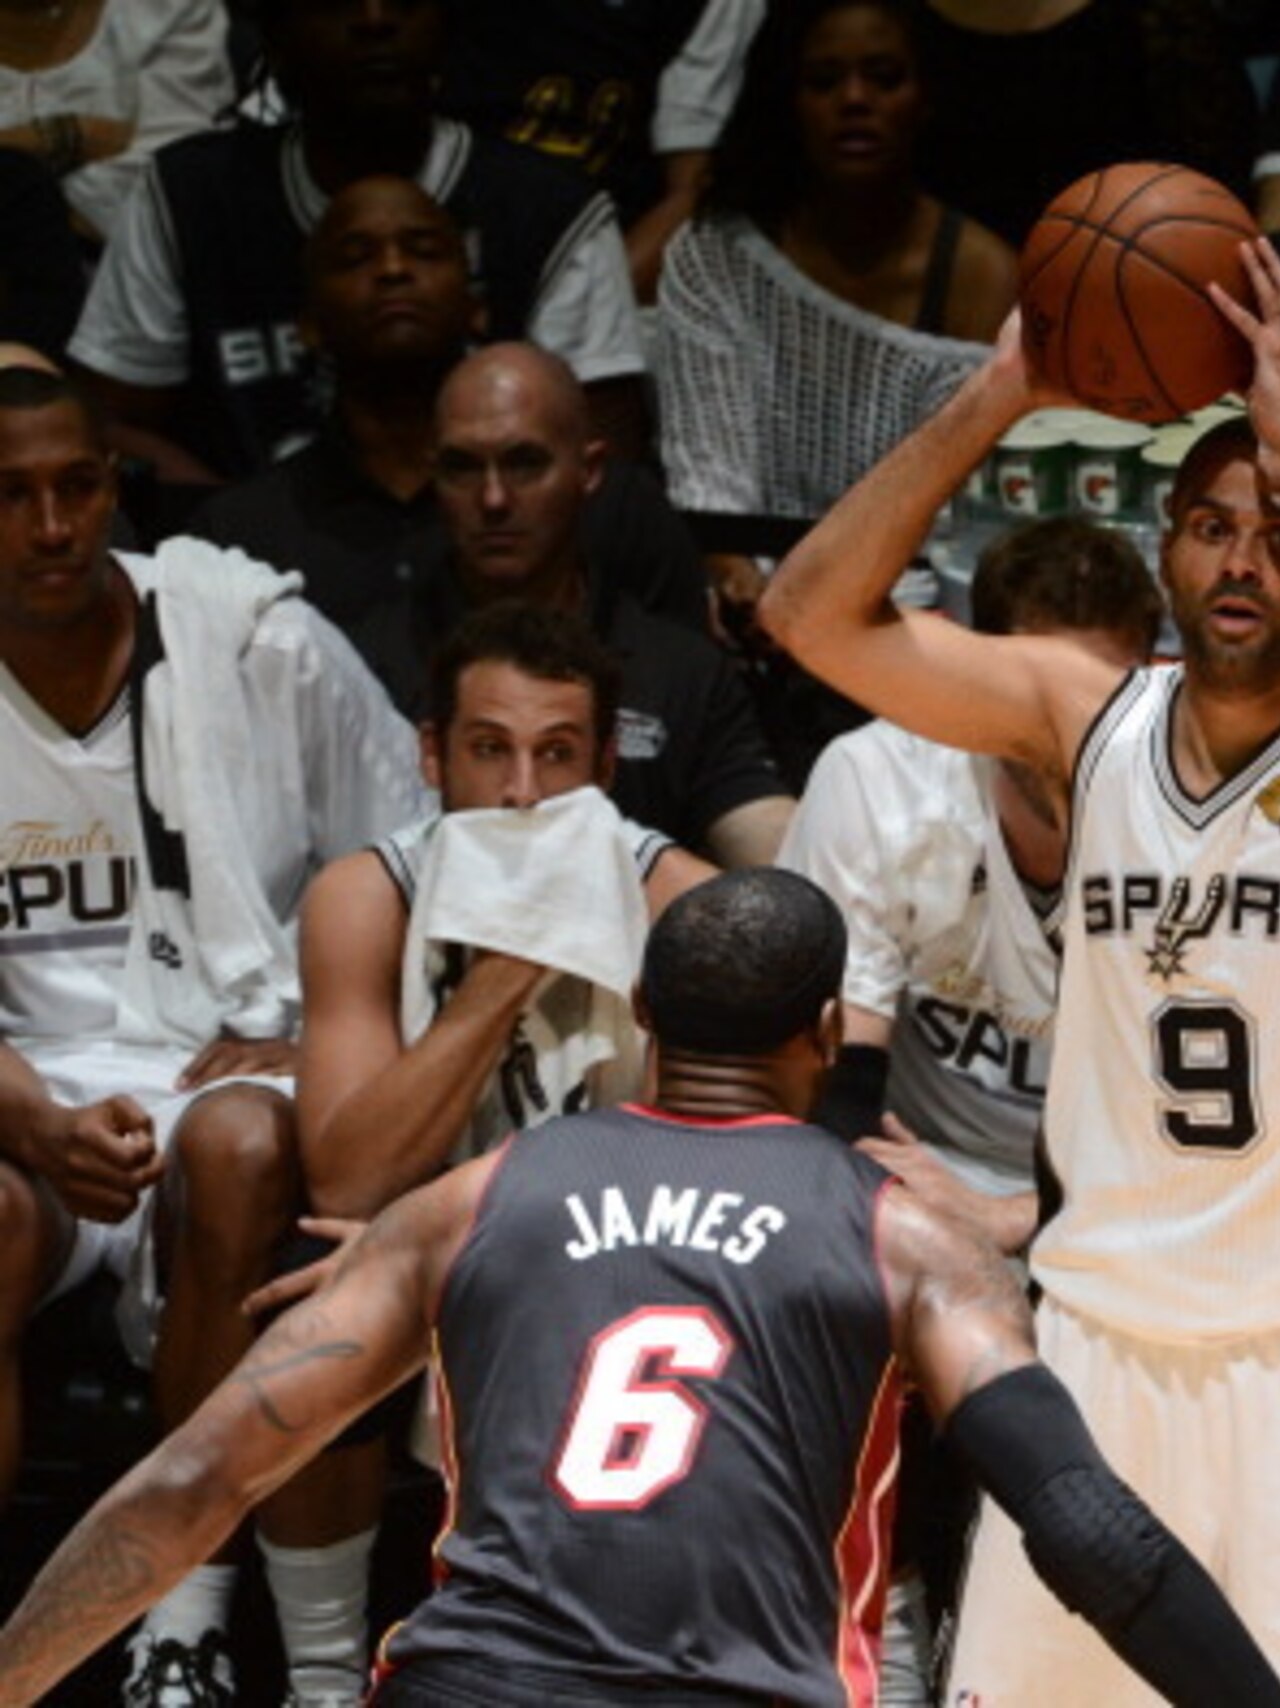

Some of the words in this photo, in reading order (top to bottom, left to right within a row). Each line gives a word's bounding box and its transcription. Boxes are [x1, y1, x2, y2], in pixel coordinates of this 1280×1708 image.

[1150, 996, 1266, 1158] 9
[564, 1184, 787, 1265] JAMES
[545, 1304, 735, 1511] 6
